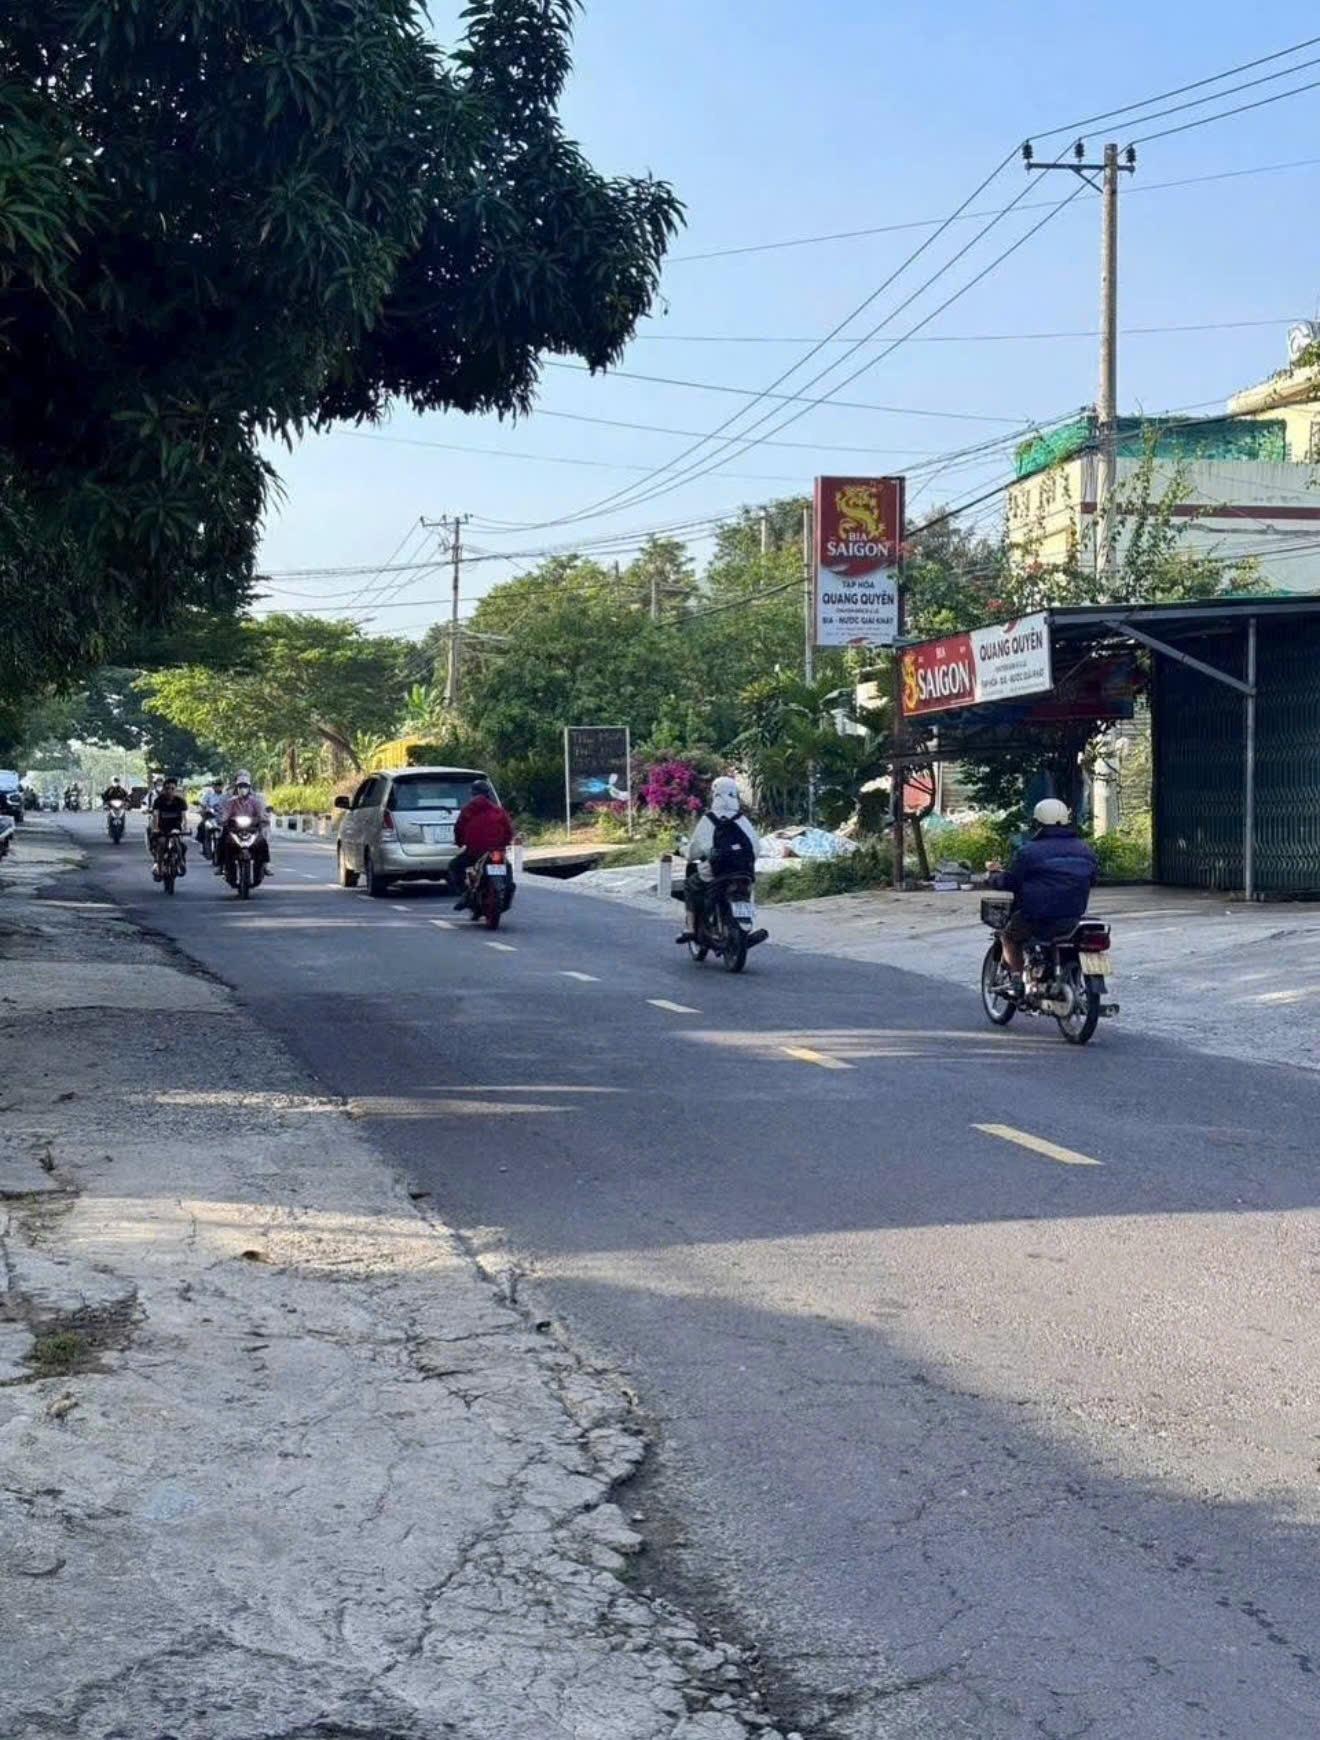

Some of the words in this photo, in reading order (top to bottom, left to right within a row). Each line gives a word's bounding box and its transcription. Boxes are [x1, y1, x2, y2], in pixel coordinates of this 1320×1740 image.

[827, 541, 889, 556] SAIGON
[821, 593, 859, 605] QUANG
[980, 638, 1010, 661] QUANG
[917, 659, 970, 700] SAIGON
